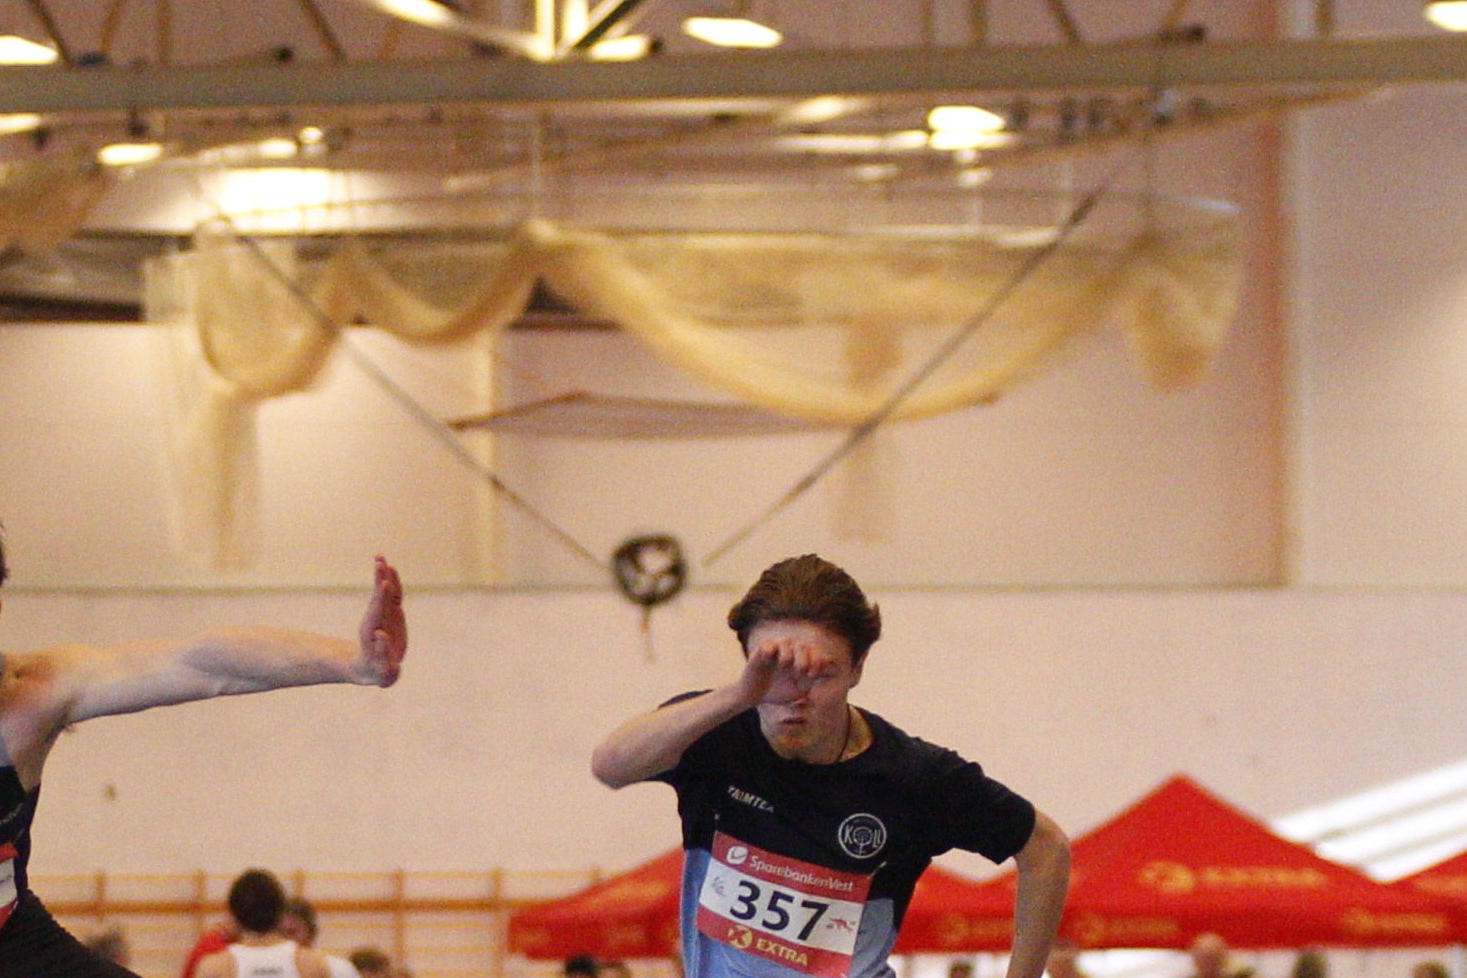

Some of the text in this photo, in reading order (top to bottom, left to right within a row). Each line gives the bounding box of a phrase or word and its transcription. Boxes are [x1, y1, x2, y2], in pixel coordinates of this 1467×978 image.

[749, 854, 854, 892] SparebankenVest
[728, 879, 830, 942] 357
[755, 937, 809, 965] EXTRA
